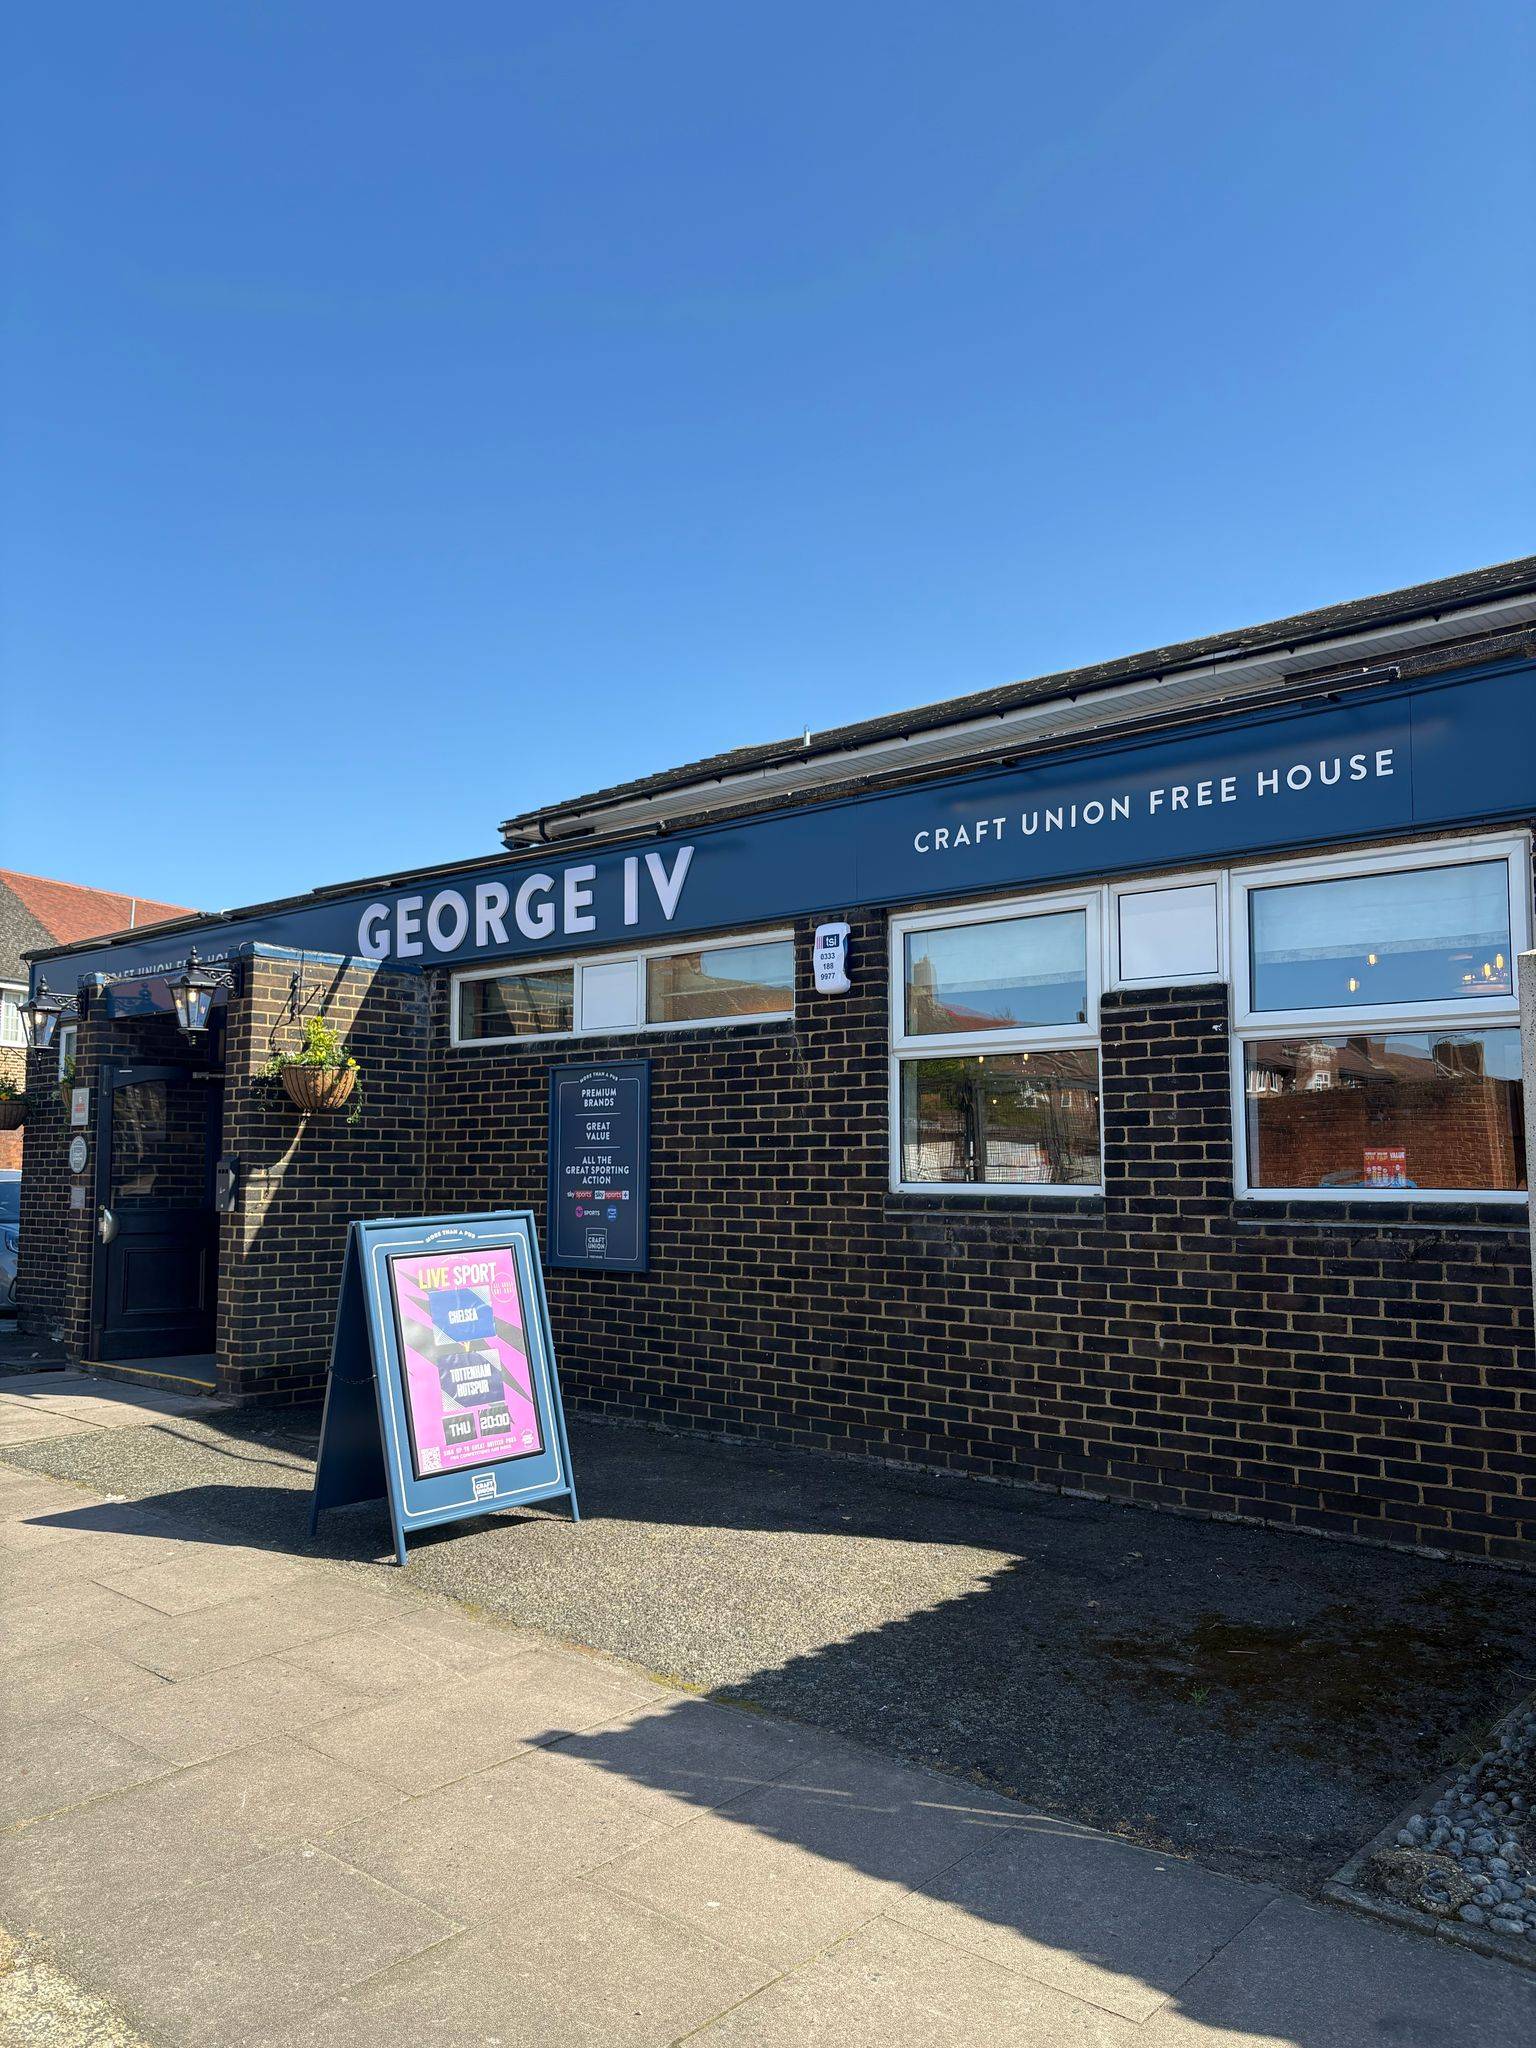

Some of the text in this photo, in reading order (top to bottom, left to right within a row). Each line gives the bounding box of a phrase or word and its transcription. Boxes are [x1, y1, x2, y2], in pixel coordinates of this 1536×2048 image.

[913, 749, 1394, 853] CRAFT UNION FREE HOUSE
[357, 845, 695, 960] GEORGE IV
[826, 935, 837, 947] tsi
[820, 952, 836, 960] 0333
[820, 972, 836, 980] 9977
[580, 1073, 592, 1083] MORE
[581, 1088, 617, 1098] PREMIUM
[584, 1098, 614, 1107] BRANDS
[586, 1122, 611, 1131] GREAT
[586, 1132, 610, 1140] VALUE
[582, 1156, 612, 1164] ALL THE
[565, 1166, 630, 1174] GREAT SPORTING
[582, 1176, 611, 1184] ACTION
[425, 1232, 441, 1243] MORE
[464, 1230, 476, 1239] PUB
[418, 1262, 496, 1289] LIVE SPORT
[448, 1307, 478, 1324] CHELSEA
[449, 1363, 492, 1383] TOTTENHAM
[456, 1380, 490, 1397] HOTSPUR
[449, 1412, 510, 1437] THU 20:00
[476, 1480, 493, 1490] CRAFT
